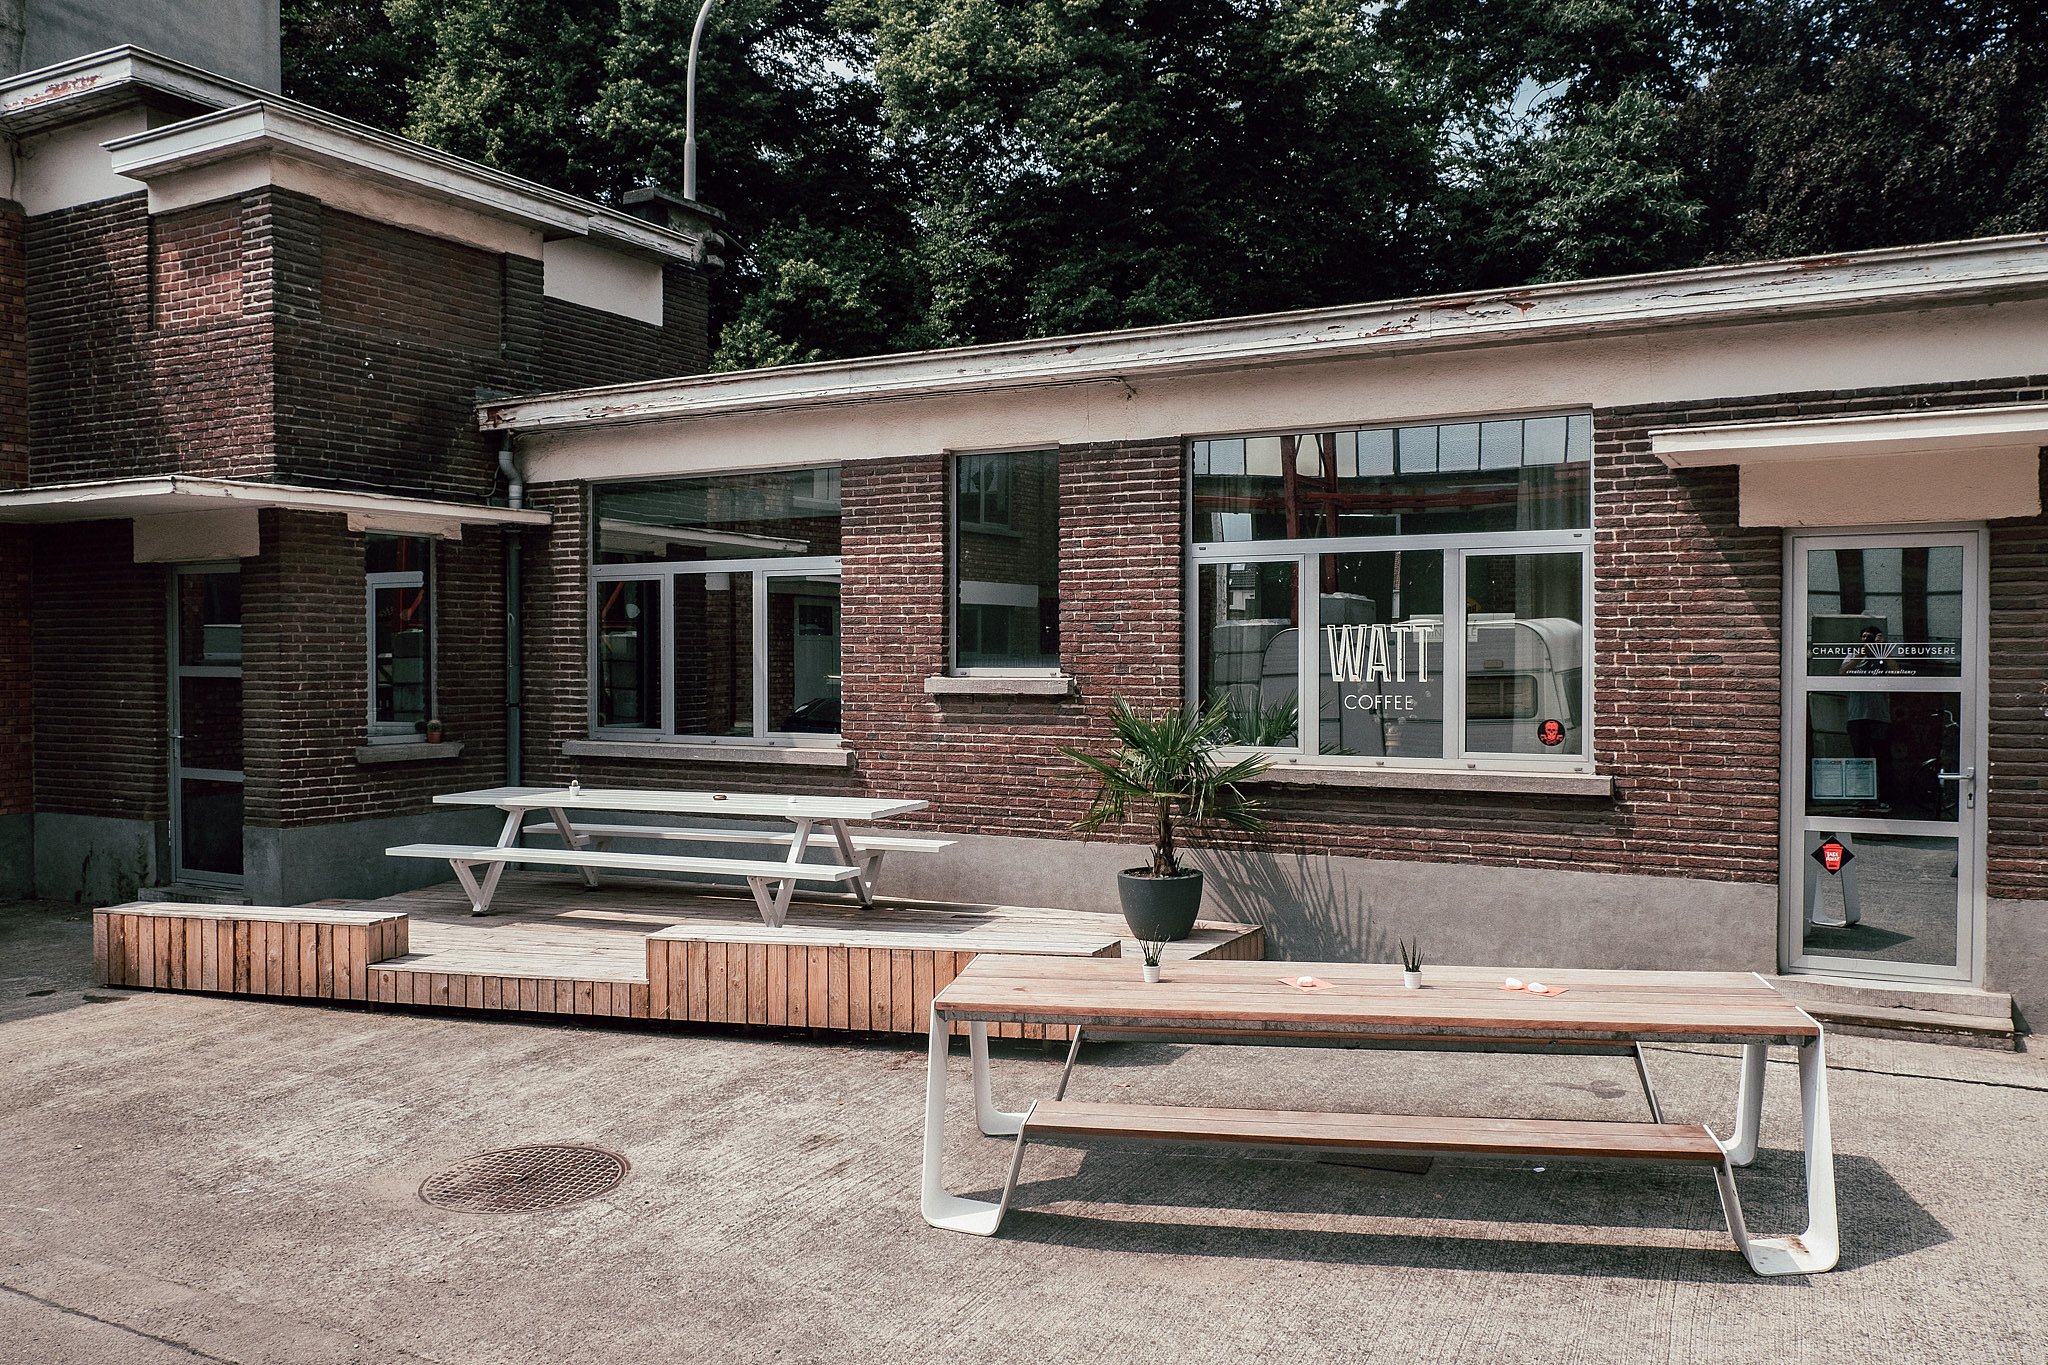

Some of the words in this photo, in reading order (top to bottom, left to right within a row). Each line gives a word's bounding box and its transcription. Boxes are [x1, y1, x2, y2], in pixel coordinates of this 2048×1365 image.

[1327, 624, 1434, 682] WATT
[1812, 647, 1866, 655] CHARLENE
[1897, 647, 1956, 655] DEBUYSERE
[1344, 695, 1414, 710] COFFEE
